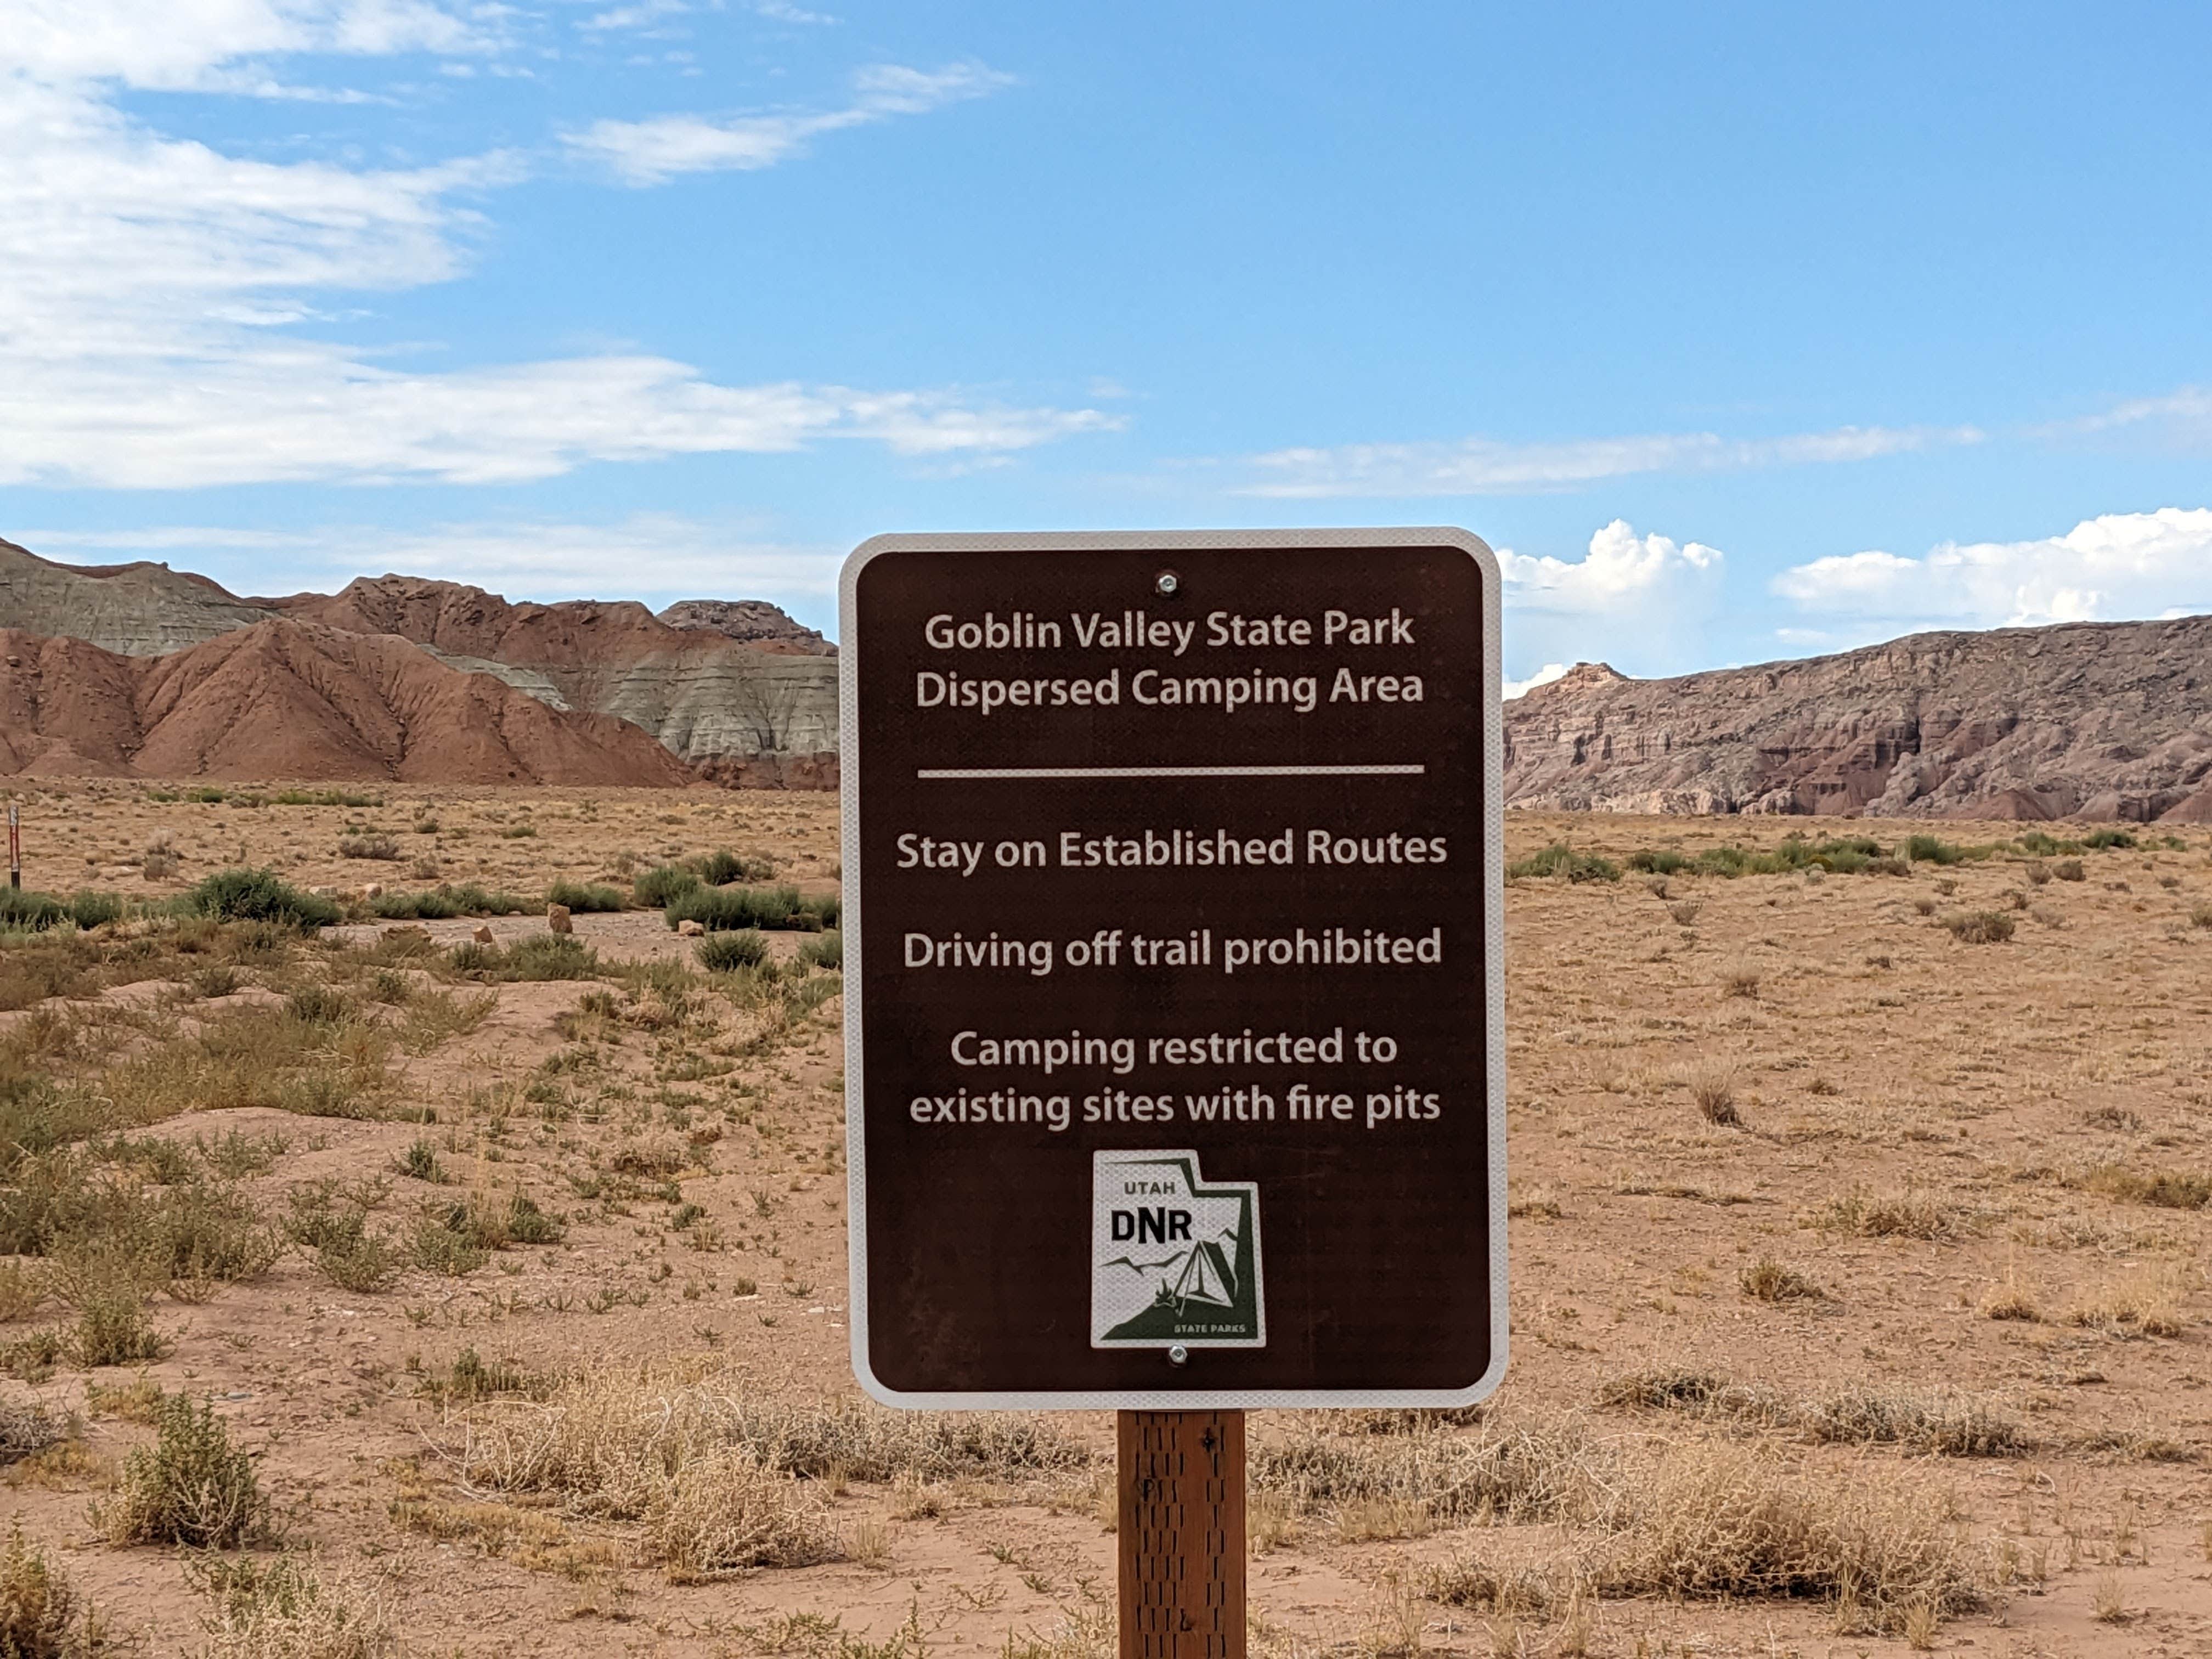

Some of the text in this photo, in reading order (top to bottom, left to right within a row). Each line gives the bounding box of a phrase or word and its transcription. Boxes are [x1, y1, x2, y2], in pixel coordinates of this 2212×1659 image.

[926, 608, 1414, 656] Goblin Valley State Park
[918, 668, 1423, 714] Dispersed Camping Area
[898, 829, 1446, 876] Stay on Established Routes
[905, 928, 1441, 975] Driving off trail prohibited
[952, 1028, 1397, 1074] Camping restricted to
[911, 1085, 1440, 1131] existing sites with fire pits
[1124, 1181, 1175, 1196] UTAH
[1111, 1206, 1192, 1244] DNR
[1174, 1324, 1246, 1333] STATE PARKS
